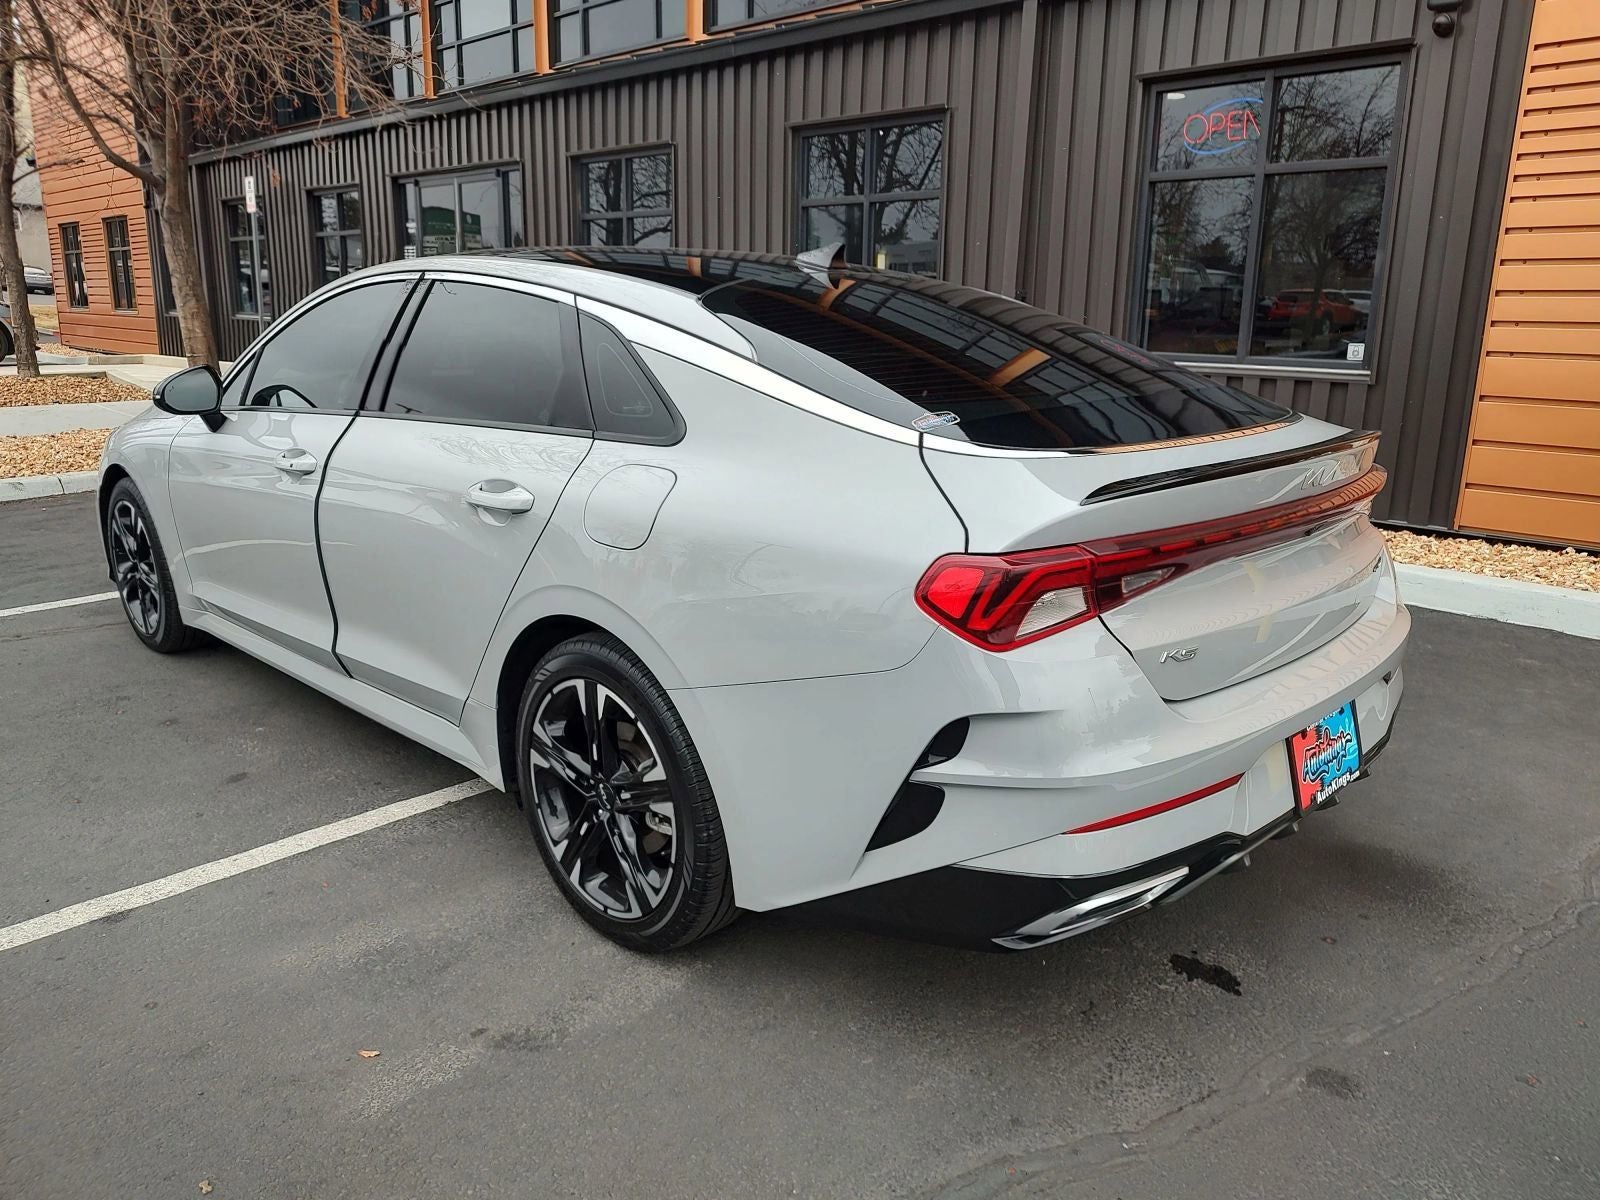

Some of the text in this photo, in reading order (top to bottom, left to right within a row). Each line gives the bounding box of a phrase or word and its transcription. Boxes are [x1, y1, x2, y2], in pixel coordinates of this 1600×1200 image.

[1183, 110, 1261, 144] OPEN
[1160, 647, 1199, 664] K5
[1316, 770, 1360, 804] AutoKings.com
